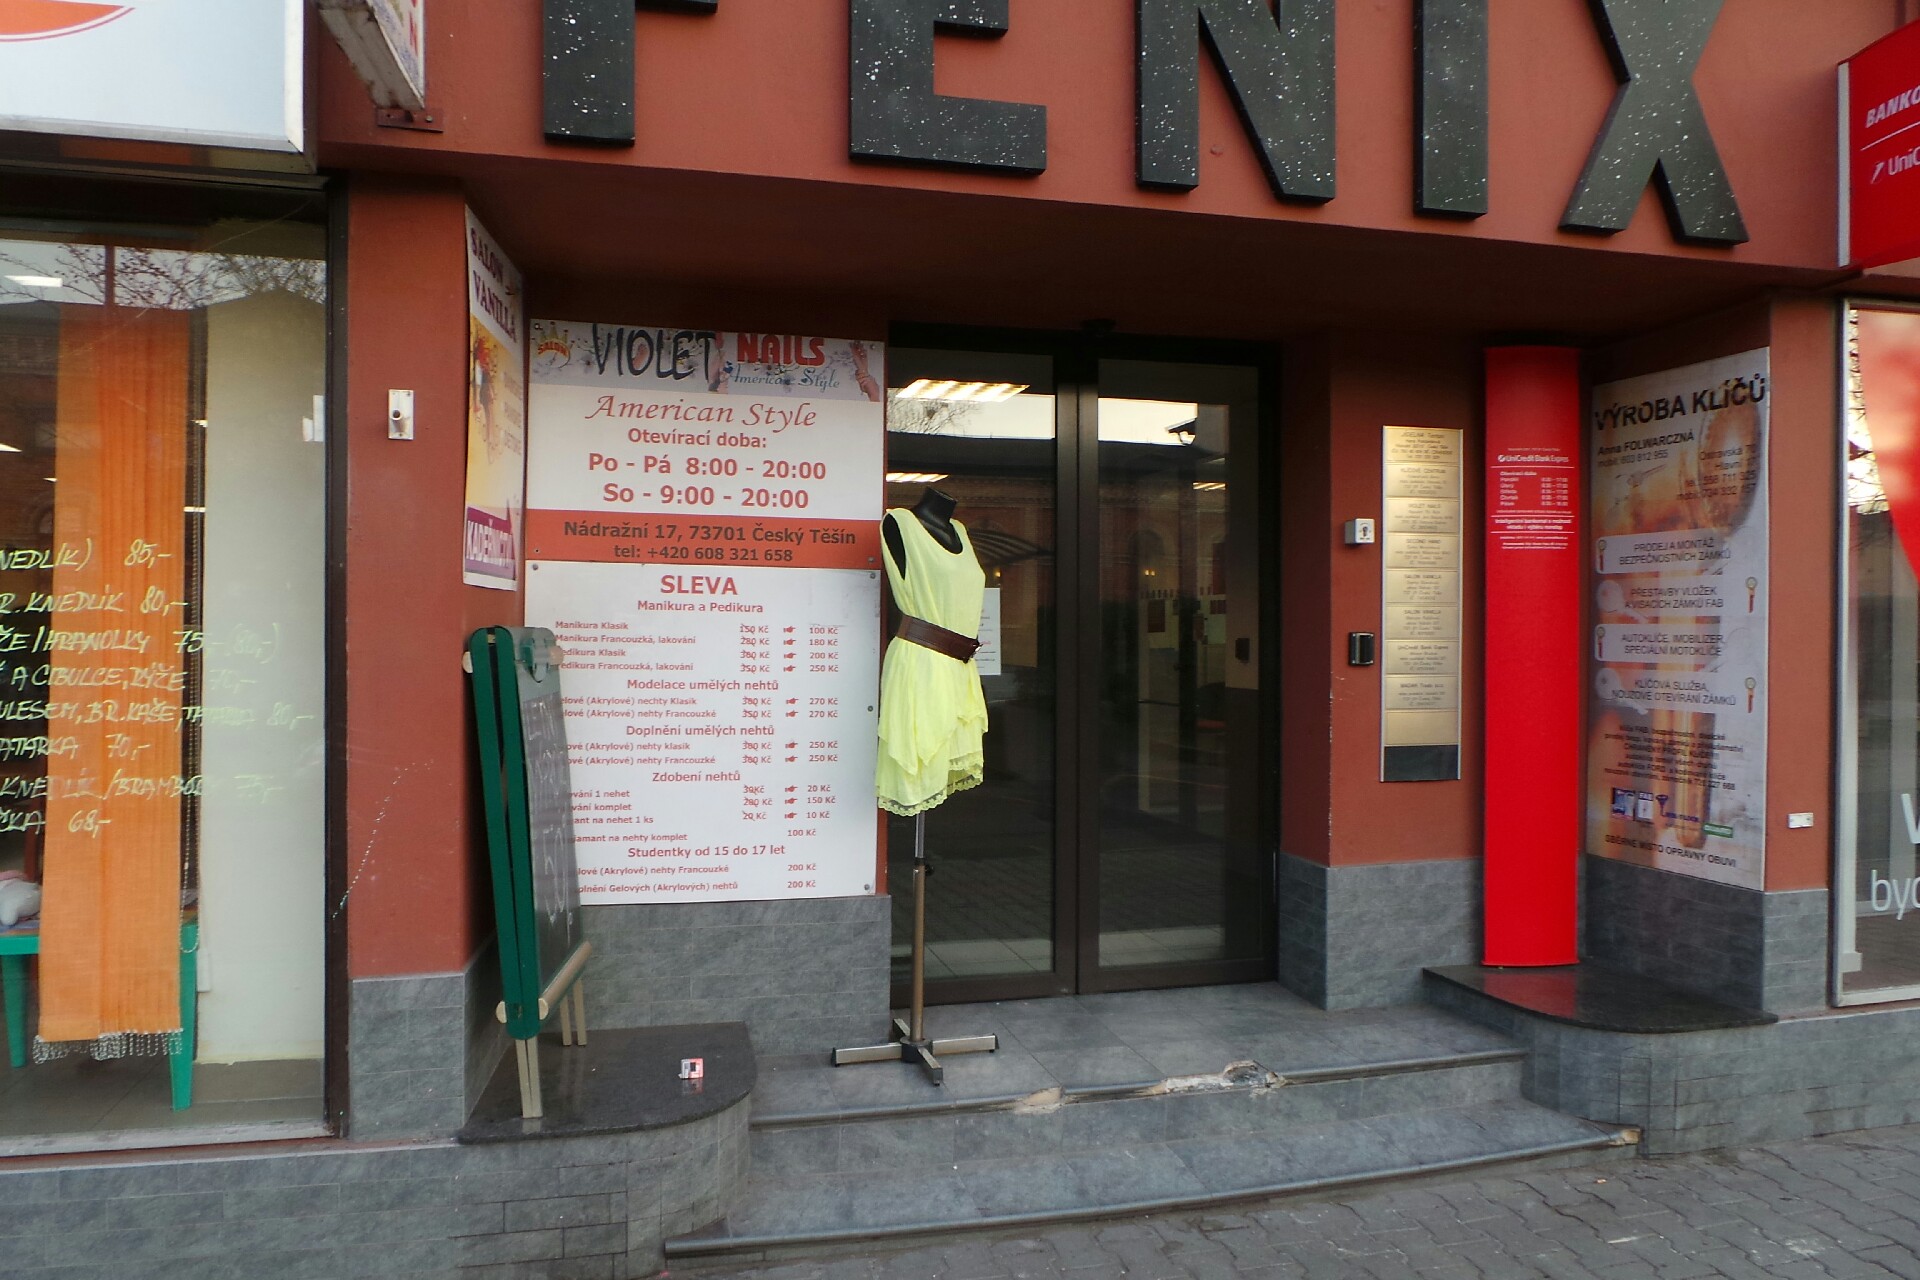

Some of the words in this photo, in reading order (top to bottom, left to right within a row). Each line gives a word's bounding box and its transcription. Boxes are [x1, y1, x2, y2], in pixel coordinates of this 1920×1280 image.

[592, 324, 717, 383] VIOLET
[737, 332, 826, 366] NAILS
[798, 367, 841, 393] Style
[1594, 394, 1687, 431] VÝROBA
[1692, 373, 1766, 414] KLÍČŮ
[585, 395, 734, 423] American
[742, 402, 817, 433] Style
[628, 428, 711, 446] Otevírací
[716, 432, 767, 448] doba:
[588, 452, 618, 472] Po
[644, 454, 671, 474] Pá
[686, 457, 737, 476] 8:00
[762, 459, 826, 480] 20:00
[603, 482, 634, 503] So
[660, 485, 715, 506] 9:00
[741, 487, 809, 509] 20:00
[563, 519, 649, 539] Nádražní
[655, 524, 683, 542] 17,
[689, 525, 746, 541] 73701
[752, 522, 804, 546] Český
[809, 527, 856, 545] Těšín
[614, 545, 641, 558] tel:
[647, 546, 689, 559] +420
[694, 547, 724, 560] 608
[729, 547, 758, 561] 321
[764, 549, 793, 562] 658
[660, 574, 738, 595] SLEVA
[637, 600, 695, 612] Manikura
[698, 604, 706, 612] a
[709, 601, 764, 613] Pedikura
[554, 621, 599, 630] Manikura
[601, 621, 629, 630] Klasik
[758, 625, 769, 634] Kč
[809, 627, 825, 635] 100
[827, 626, 839, 635] Kč
[555, 634, 598, 643] Manikura
[600, 634, 656, 645] Francouzká,
[658, 635, 696, 644] lakování
[827, 638, 839, 646] Kč
[562, 648, 596, 656] edikura
[598, 649, 626, 657] Klasik
[828, 651, 839, 659] Kč
[560, 662, 595, 670] edikura
[598, 662, 653, 671] Francouzká,
[656, 663, 694, 671] lakování
[759, 664, 770, 672] Kč
[809, 664, 826, 672] 250
[828, 664, 839, 672] Kč
[627, 679, 686, 690] Modelace
[689, 679, 740, 692] umělých
[744, 680, 779, 690] nehtů
[560, 696, 584, 705] elové
[586, 696, 635, 707] (Akrylové)
[670, 697, 697, 705] Klasik
[809, 697, 825, 705] 270
[827, 697, 838, 705] Kč
[586, 709, 635, 719] (Akrylové)
[637, 709, 663, 718] nehty
[665, 710, 717, 718] Francouzké
[761, 710, 772, 718] Kč
[809, 710, 825, 718] 270
[827, 710, 838, 718] Kč
[626, 724, 681, 737] Doplnění
[685, 725, 736, 738] umělých
[740, 724, 775, 735] nehtů
[652, 771, 702, 782] Zdobení
[705, 770, 741, 781] nehtů
[603, 790, 631, 798] nehet
[820, 784, 831, 792] Kč
[594, 803, 632, 812] komplet
[825, 796, 836, 804] Kč
[606, 816, 633, 824] nehet
[819, 811, 831, 819] Kč
[575, 834, 606, 842] iamant
[622, 834, 649, 843] nehty
[651, 833, 688, 841] komplet
[806, 828, 817, 836] Kč
[628, 847, 691, 858] Studentky
[695, 846, 710, 856] od
[714, 847, 729, 856] 15
[733, 845, 748, 855] do
[752, 845, 766, 855] 17
[770, 844, 786, 855] let
[600, 867, 648, 876] (Akrylové)
[650, 866, 676, 875] nehty
[678, 864, 729, 874] Francouzké
[806, 863, 816, 871] Kč
[609, 883, 651, 893] Gelových
[653, 882, 710, 892] (Akrylových)
[712, 882, 738, 890] nehtů
[805, 880, 816, 888] Kč
